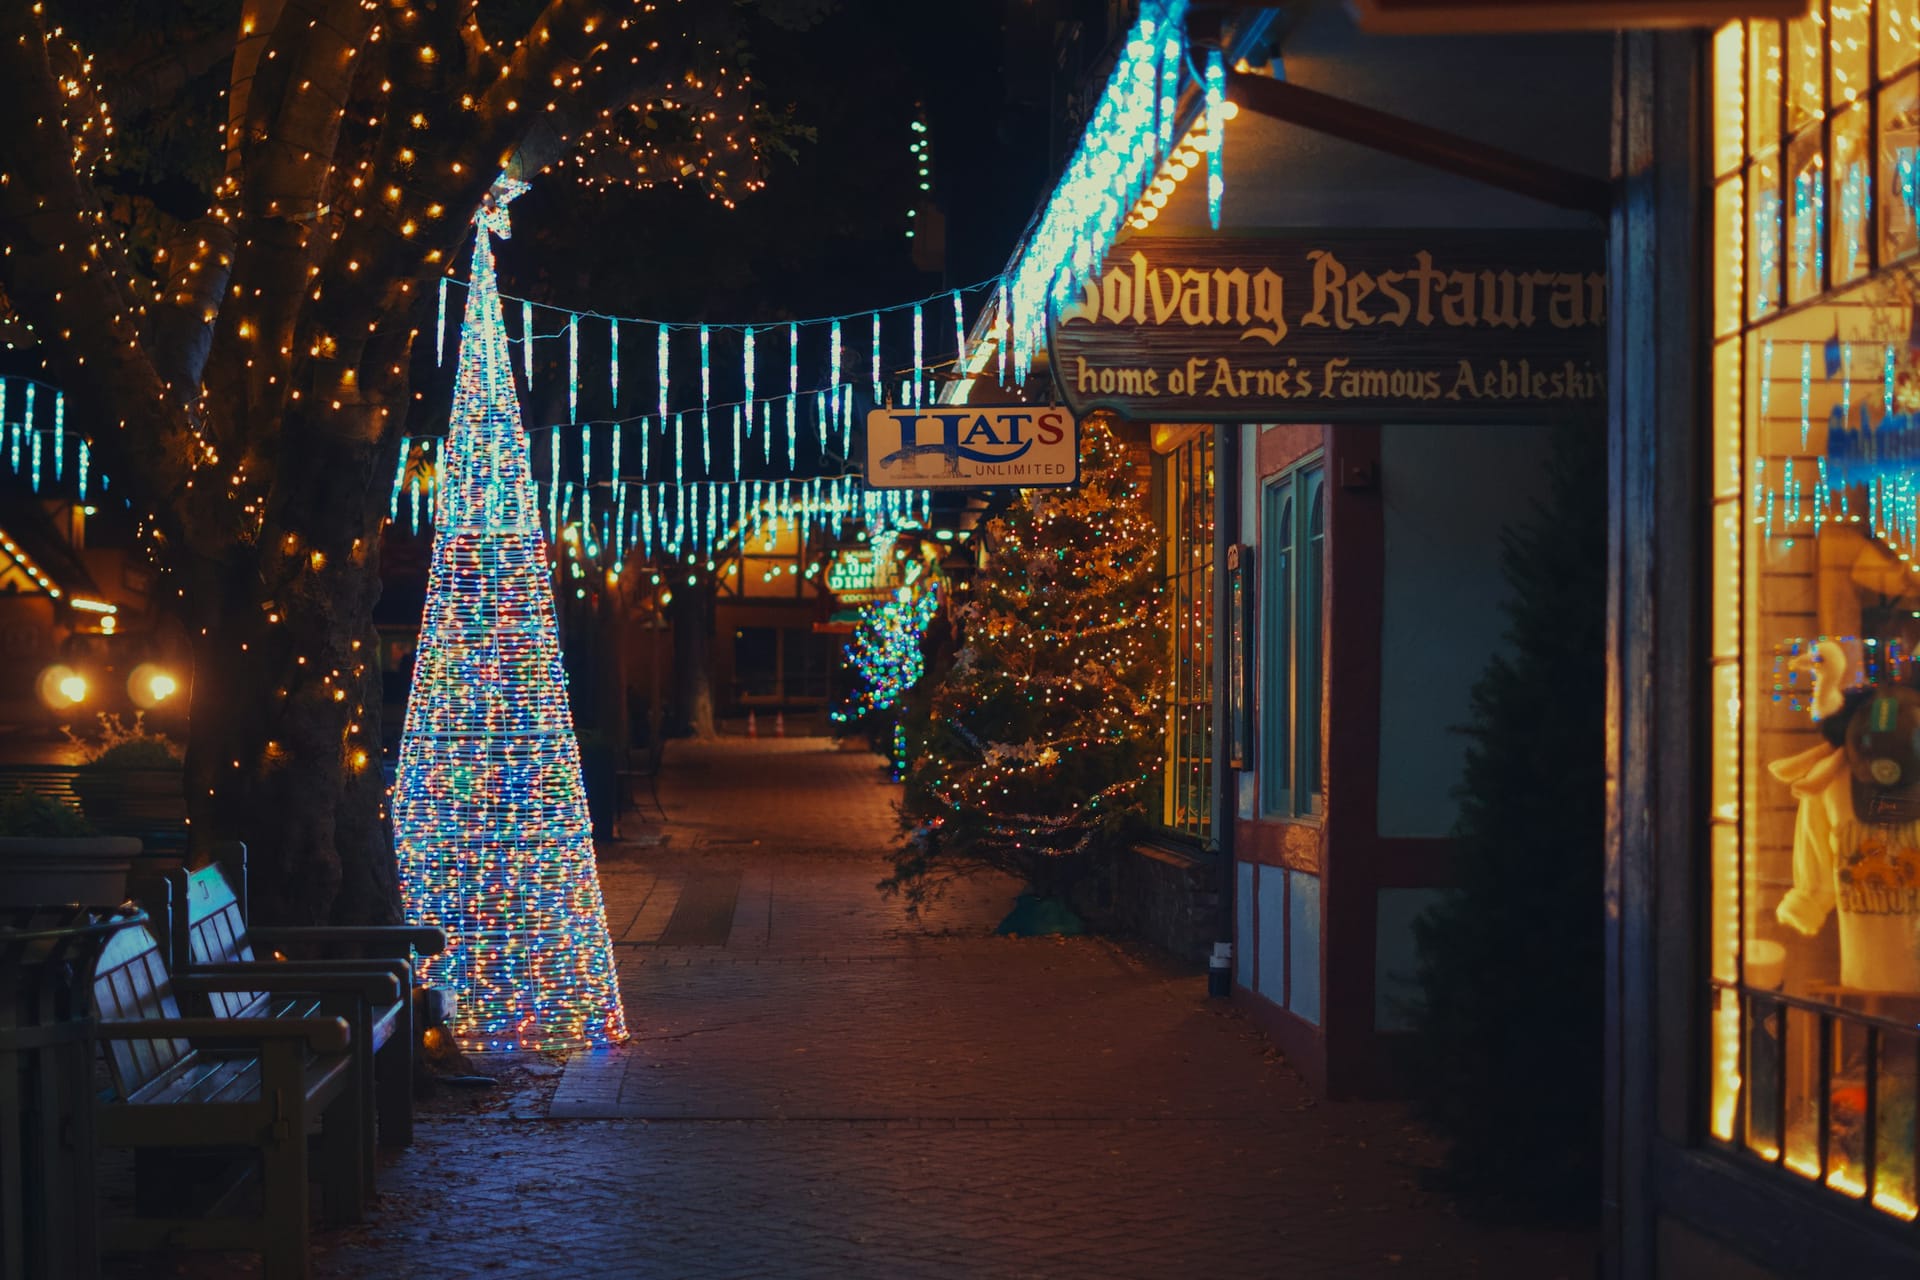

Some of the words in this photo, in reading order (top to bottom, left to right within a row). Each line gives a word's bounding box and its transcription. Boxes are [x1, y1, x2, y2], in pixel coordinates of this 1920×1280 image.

[1076, 356, 1160, 396] home
[1205, 357, 1313, 398] Arne's
[1319, 357, 1441, 399] Famous
[880, 413, 1065, 480] HATS
[975, 463, 1066, 477] UNLIMITED
